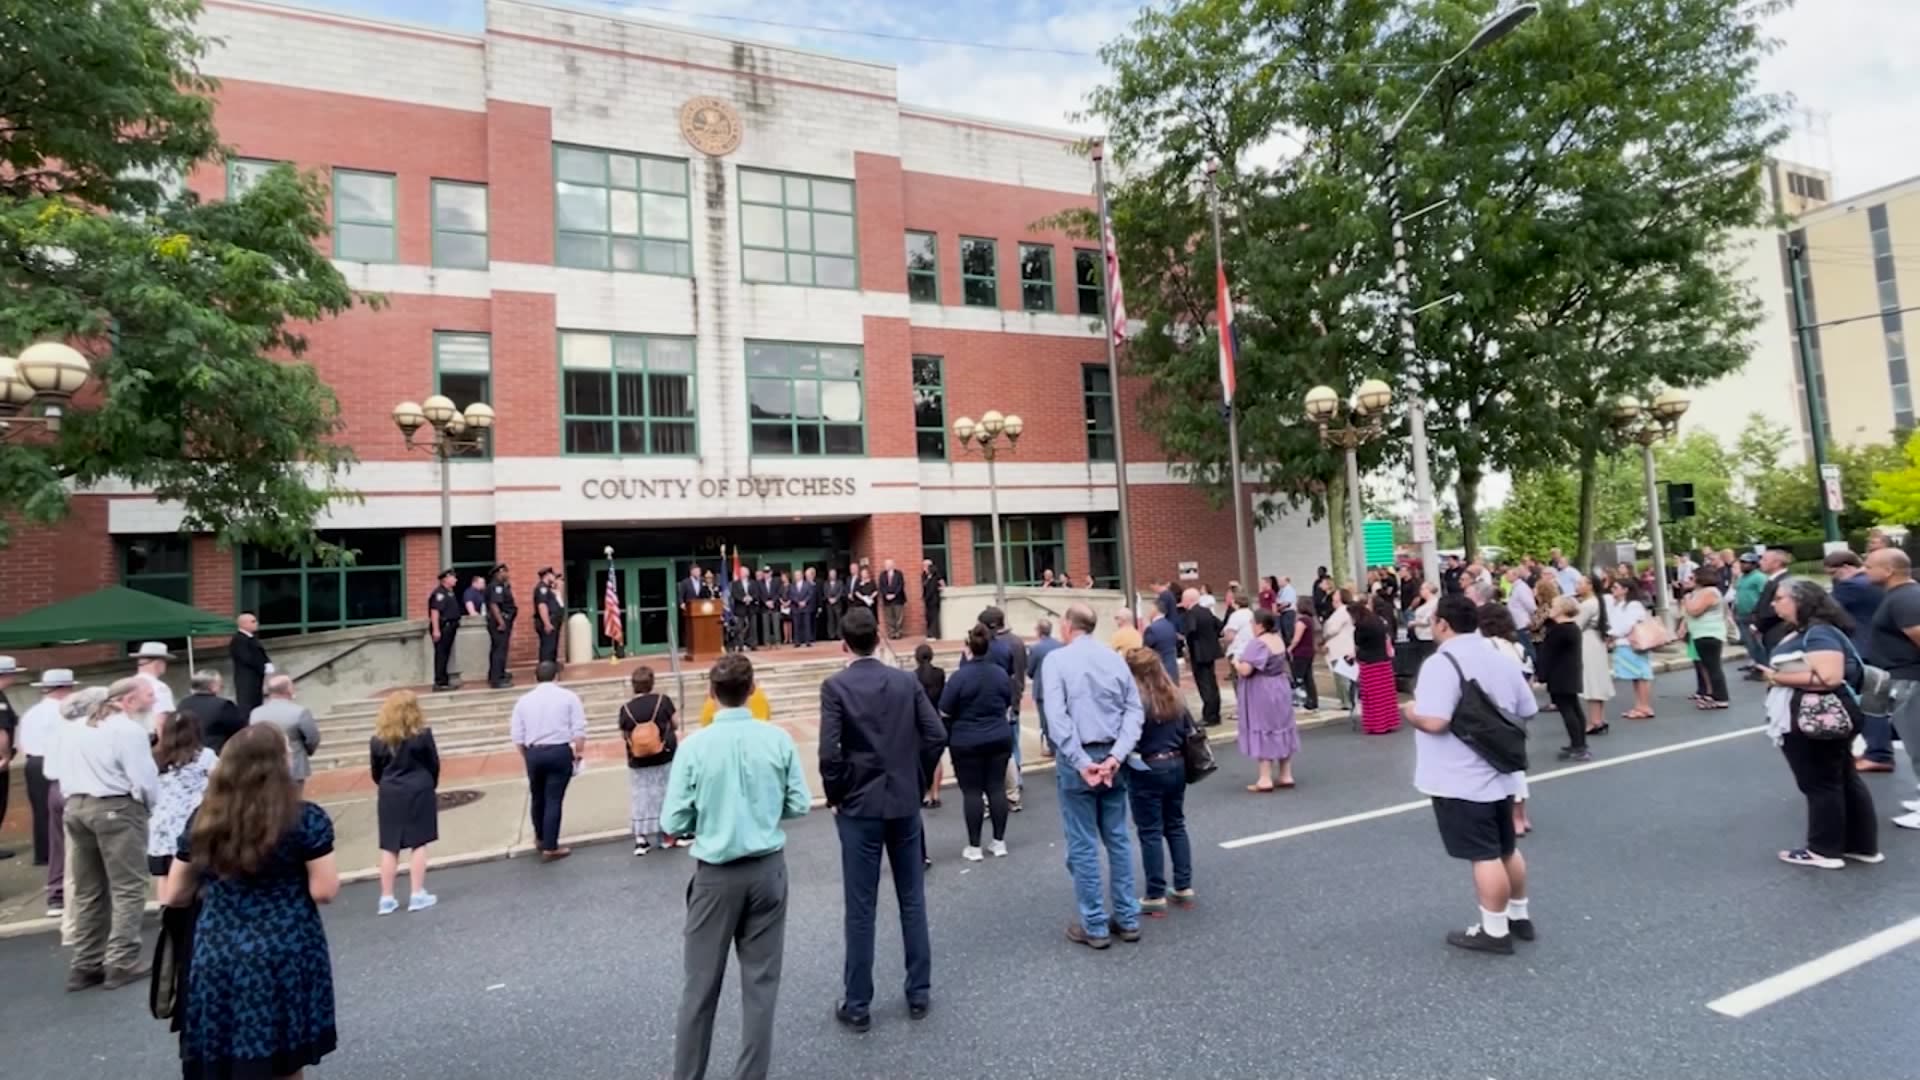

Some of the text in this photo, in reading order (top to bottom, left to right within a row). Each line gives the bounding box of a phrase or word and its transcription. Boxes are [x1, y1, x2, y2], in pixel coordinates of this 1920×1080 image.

[582, 477, 856, 499] COUNTY OF DUTCHESS
